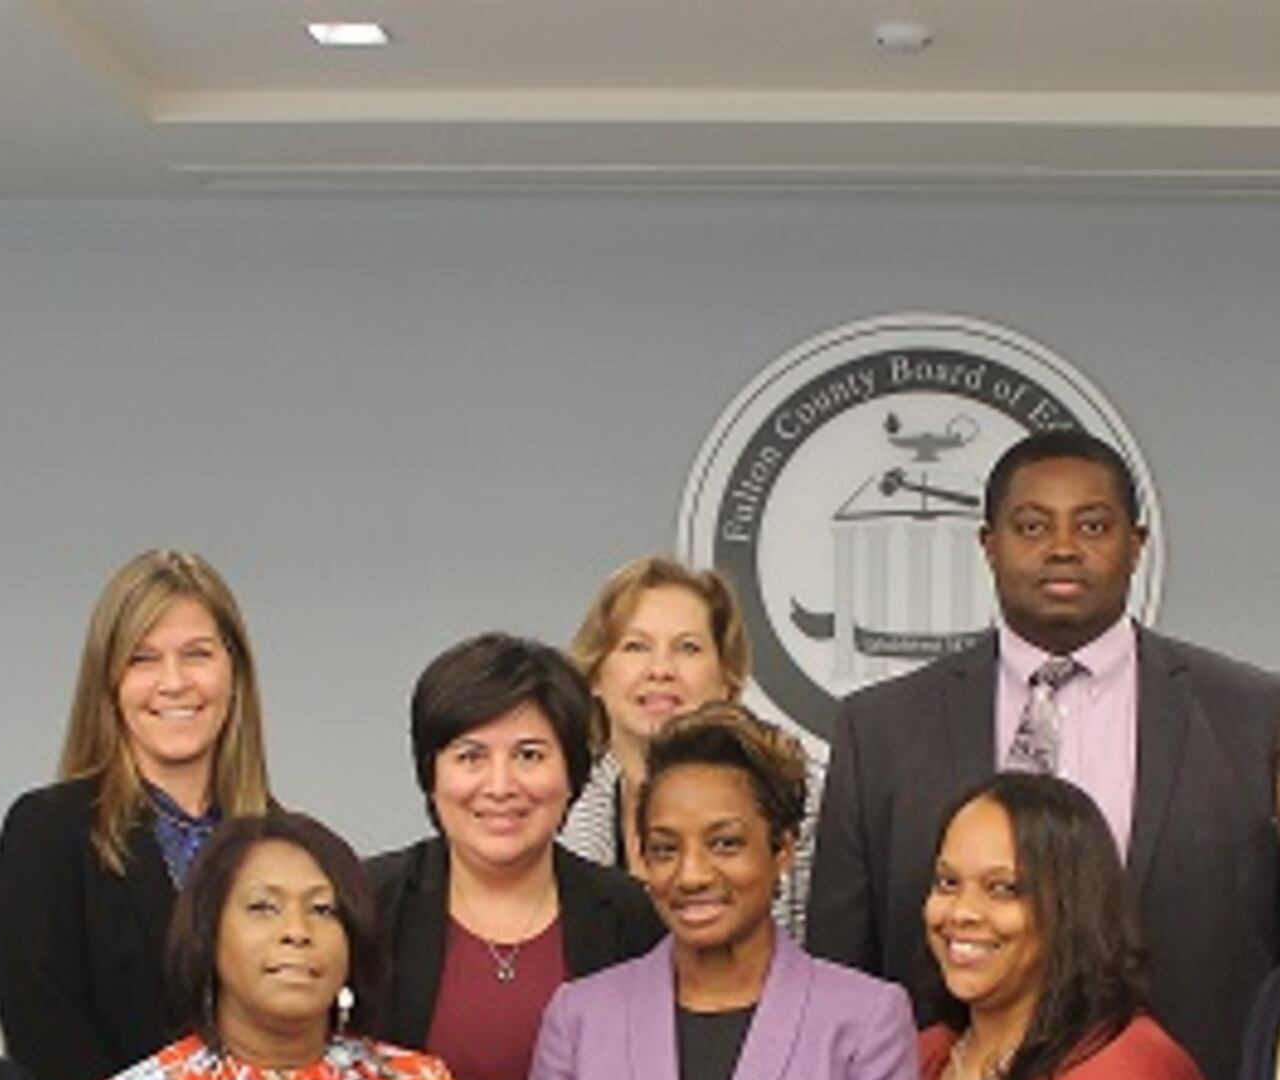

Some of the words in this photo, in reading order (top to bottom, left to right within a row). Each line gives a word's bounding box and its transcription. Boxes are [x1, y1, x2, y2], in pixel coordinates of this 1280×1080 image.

[723, 447, 783, 543] Fulton
[775, 367, 876, 441] County
[891, 356, 986, 390] Board
[993, 378, 1027, 407] of
